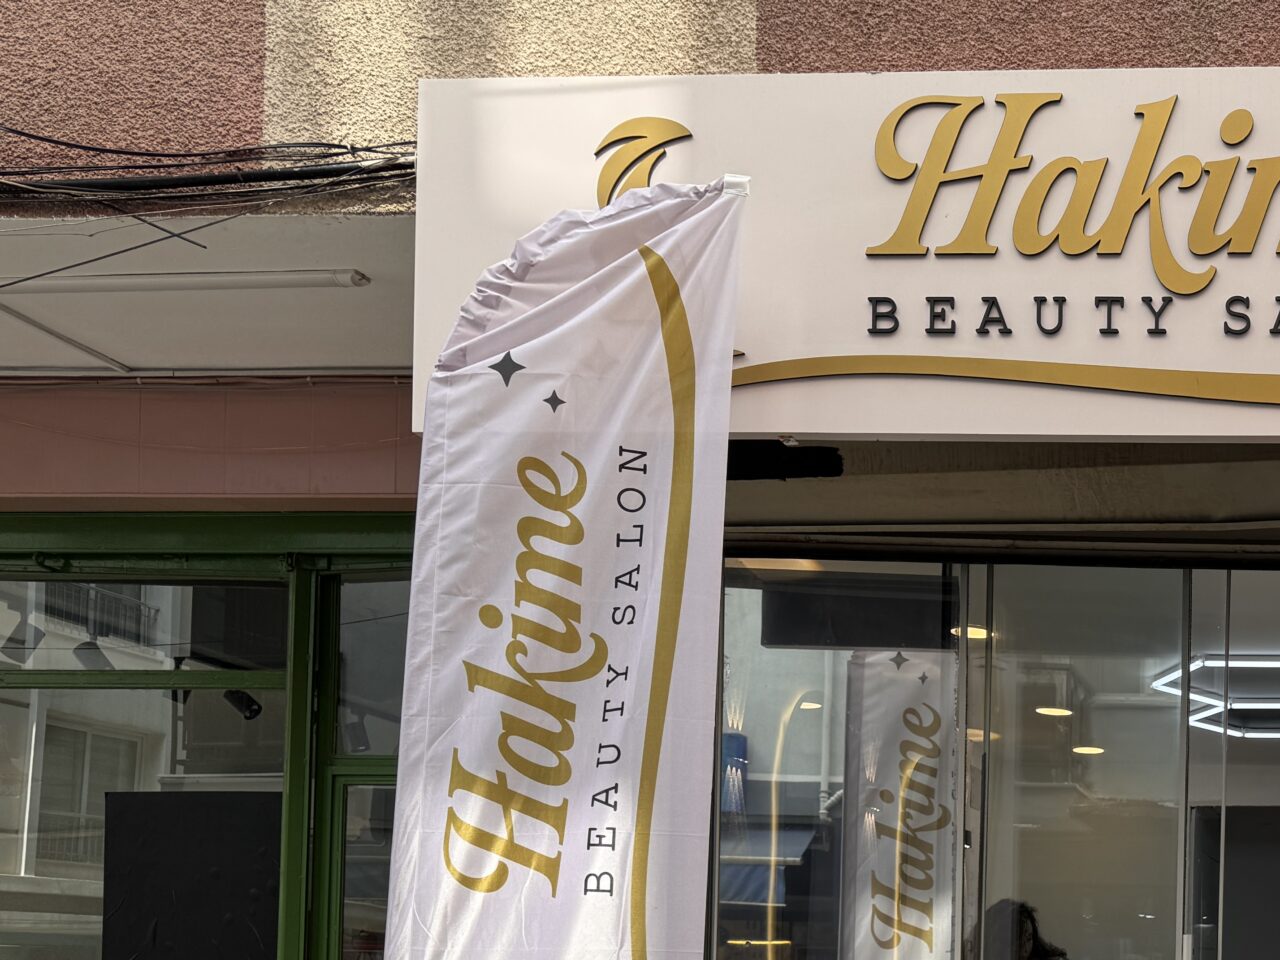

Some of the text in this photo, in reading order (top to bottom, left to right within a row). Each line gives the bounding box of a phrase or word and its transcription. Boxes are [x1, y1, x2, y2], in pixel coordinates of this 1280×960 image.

[867, 296, 1171, 336] BEAUTY
[442, 450, 609, 899] Hakime
[583, 445, 648, 897] BEAUTY SALON
[872, 704, 952, 954] Hakime
